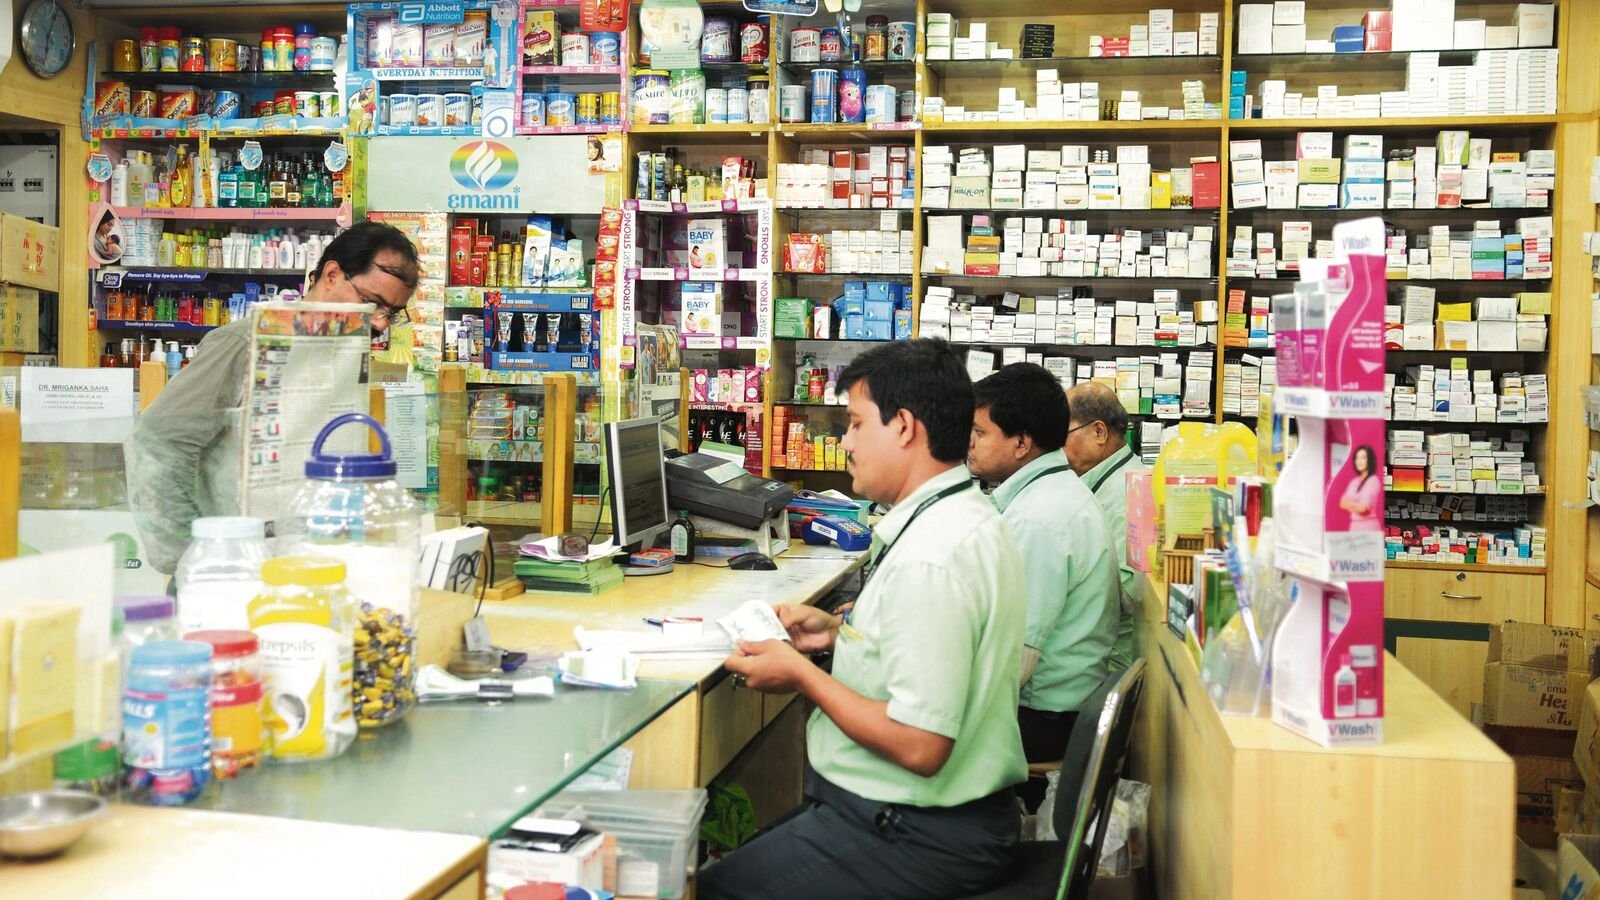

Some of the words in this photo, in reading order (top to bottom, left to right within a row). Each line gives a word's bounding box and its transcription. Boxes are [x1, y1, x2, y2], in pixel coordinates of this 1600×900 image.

[426, 12, 460, 20] Nutrition
[430, 68, 481, 76] NUTRITION
[212, 96, 239, 118] rotinex
[690, 232, 714, 240] BABY
[1329, 395, 1376, 408] VWash
[1329, 560, 1375, 572] VWash
[261, 639, 315, 653] trepsils
[1328, 724, 1374, 736] VWash
